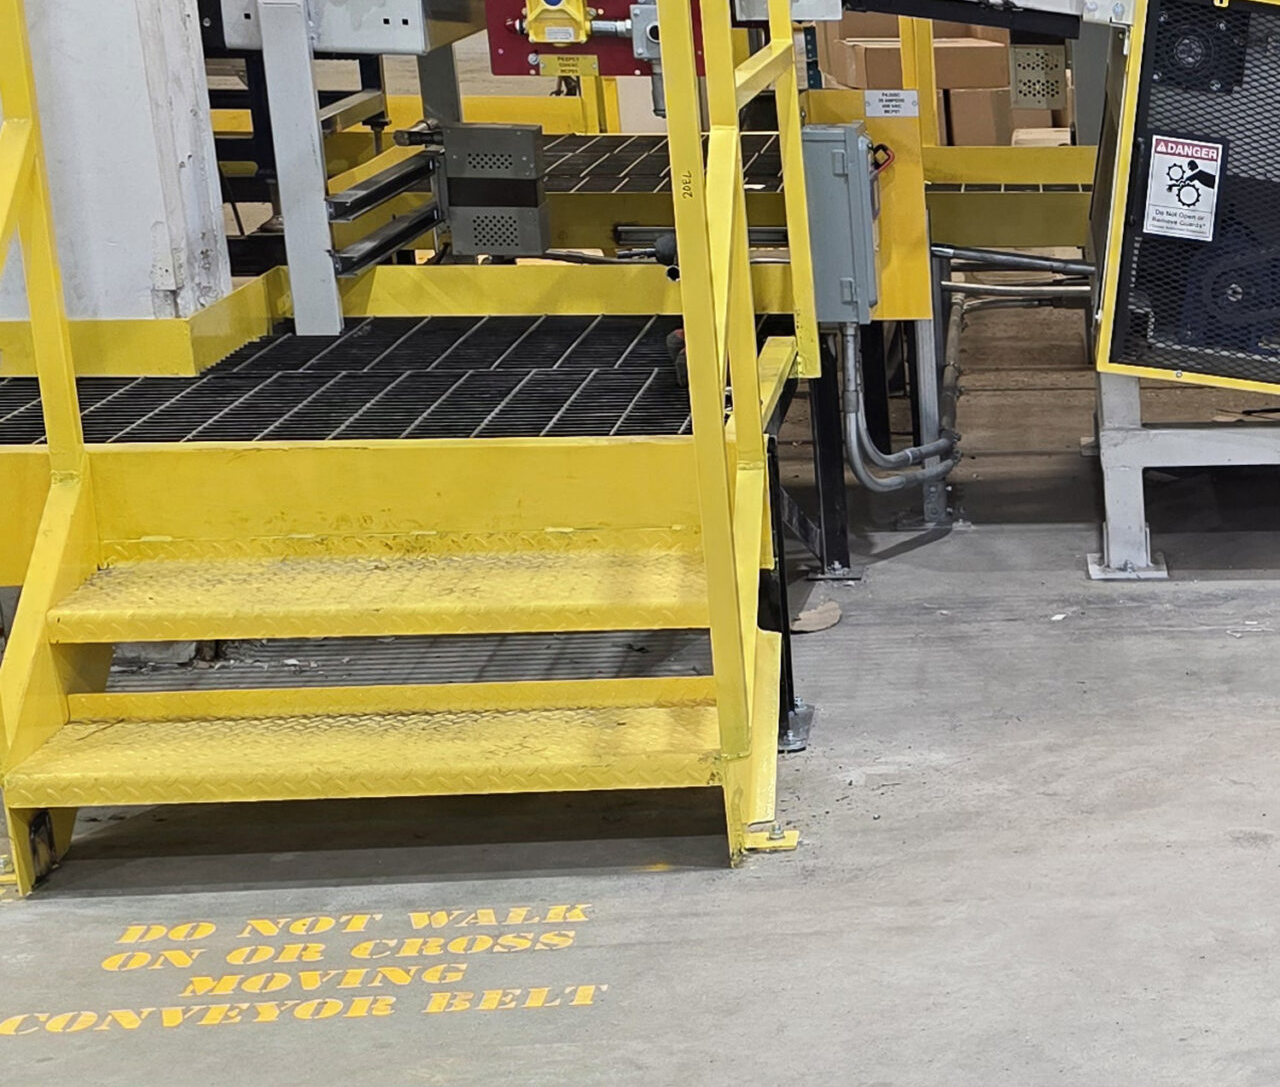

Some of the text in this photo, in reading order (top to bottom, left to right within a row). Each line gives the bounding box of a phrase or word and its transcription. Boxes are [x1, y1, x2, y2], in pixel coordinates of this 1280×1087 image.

[1167, 143, 1218, 160] DANGER
[1155, 208, 1164, 216] Do
[1166, 209, 1178, 217] Not
[1179, 211, 1197, 220] Open
[115, 904, 595, 944] DO NOT WALK
[101, 930, 579, 972] ON OR CROSS
[178, 963, 469, 998] MOVING
[0, 984, 609, 1036] CONVEYOR BELT
